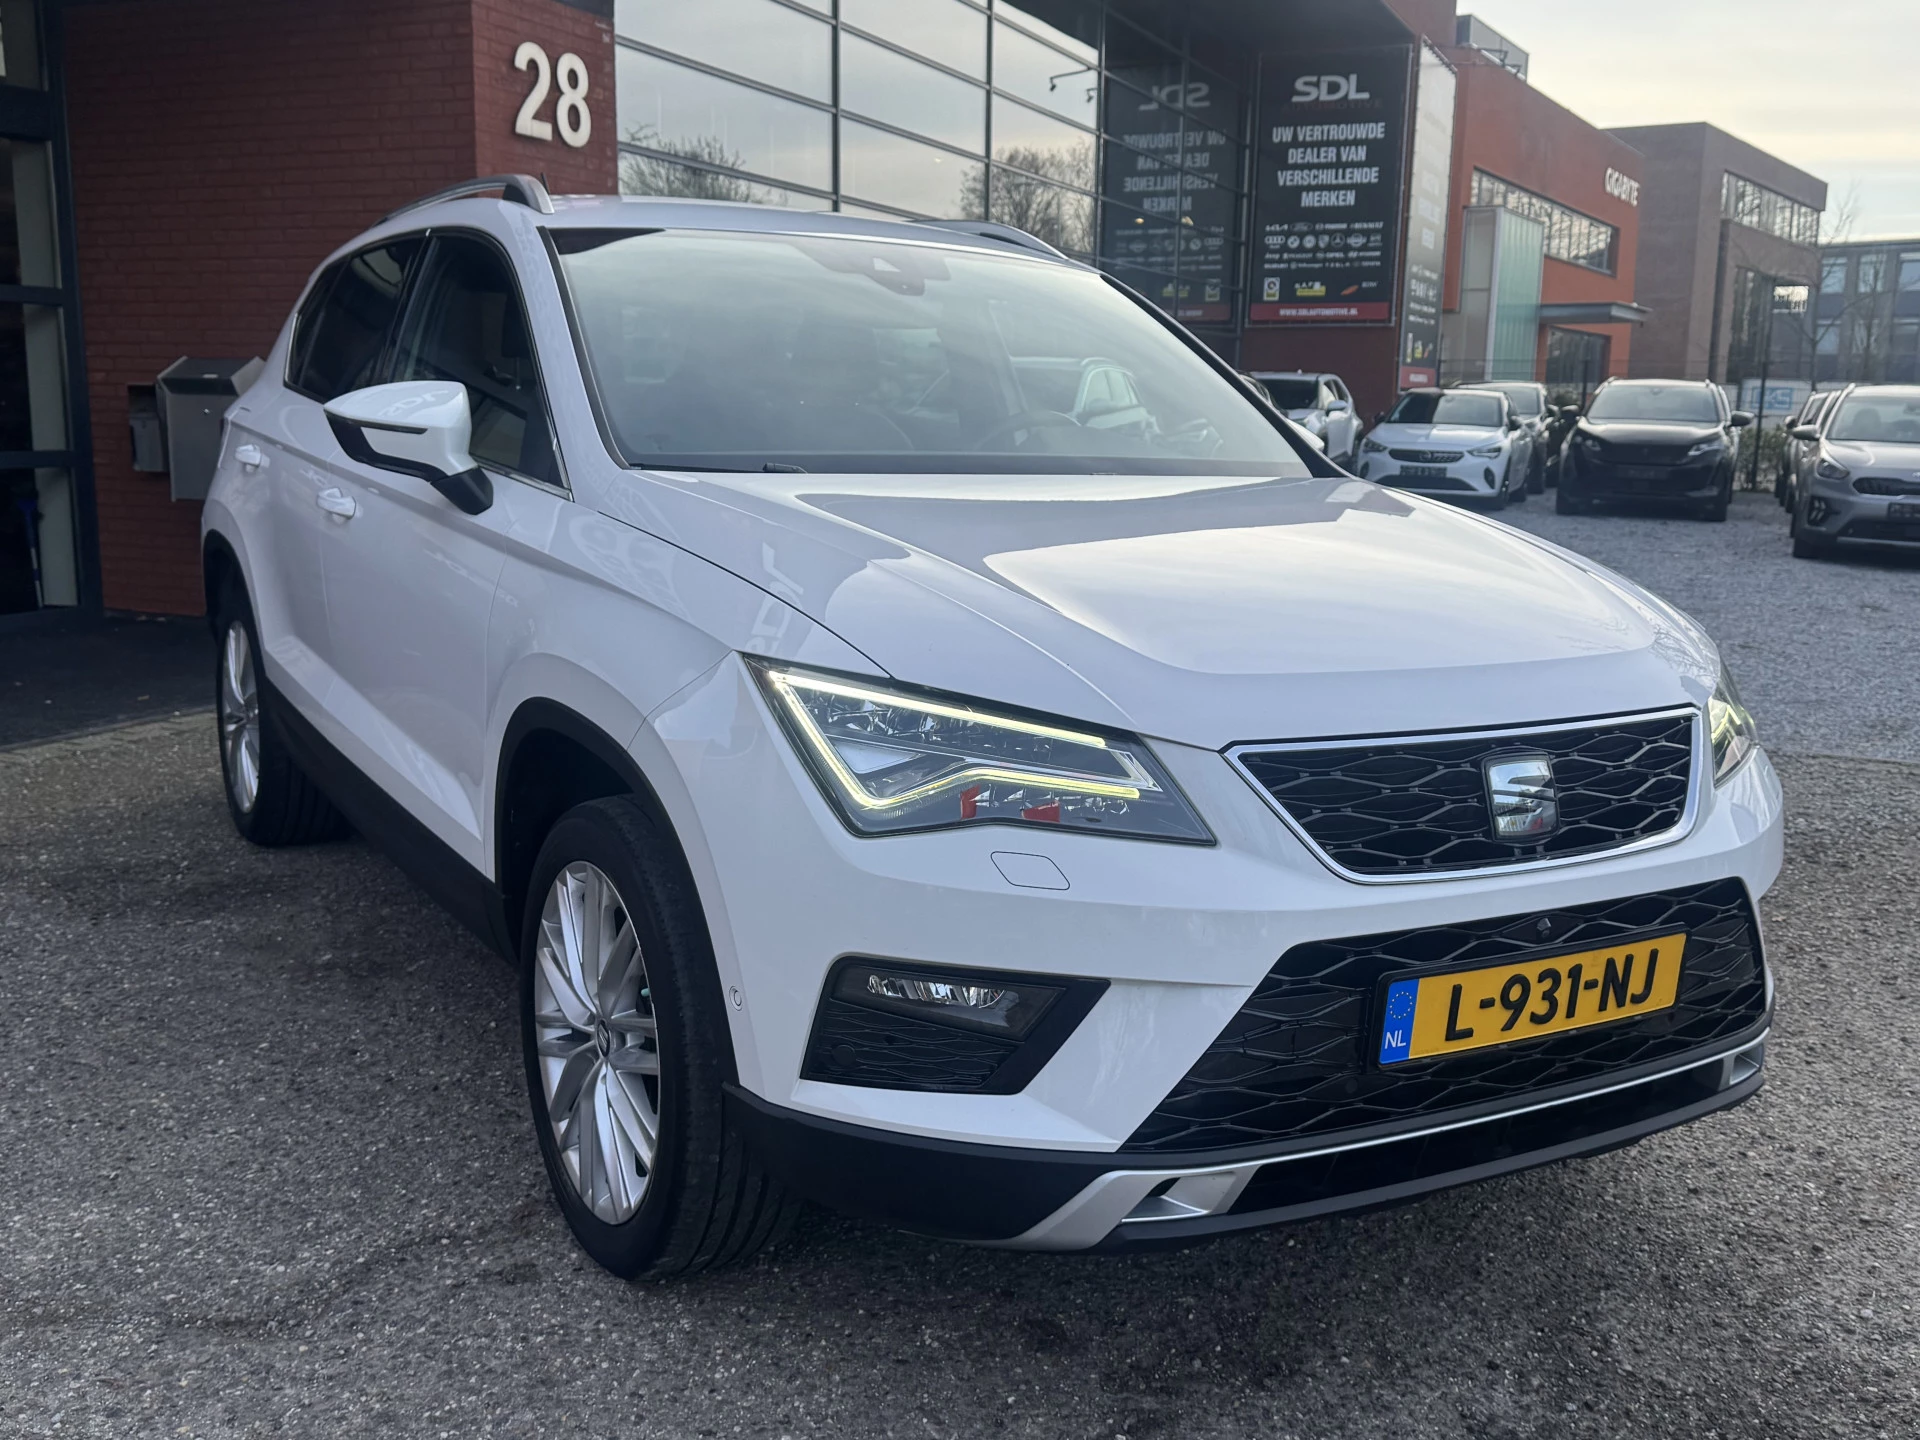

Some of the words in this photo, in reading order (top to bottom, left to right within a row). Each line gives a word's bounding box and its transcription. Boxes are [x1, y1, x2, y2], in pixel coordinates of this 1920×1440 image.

[514, 41, 592, 148] 28
[1291, 74, 1370, 102] SDL
[1272, 126, 1294, 143] UW
[1296, 122, 1386, 142] VERTROUWDE
[1288, 147, 1337, 164] DEALER
[1340, 145, 1367, 162] VAN
[1277, 167, 1379, 187] VERSCHILLENDE
[1301, 190, 1356, 207] MERKEN
[1445, 948, 1659, 1042] L-931-NJ
[1384, 1029, 1407, 1049] NL
